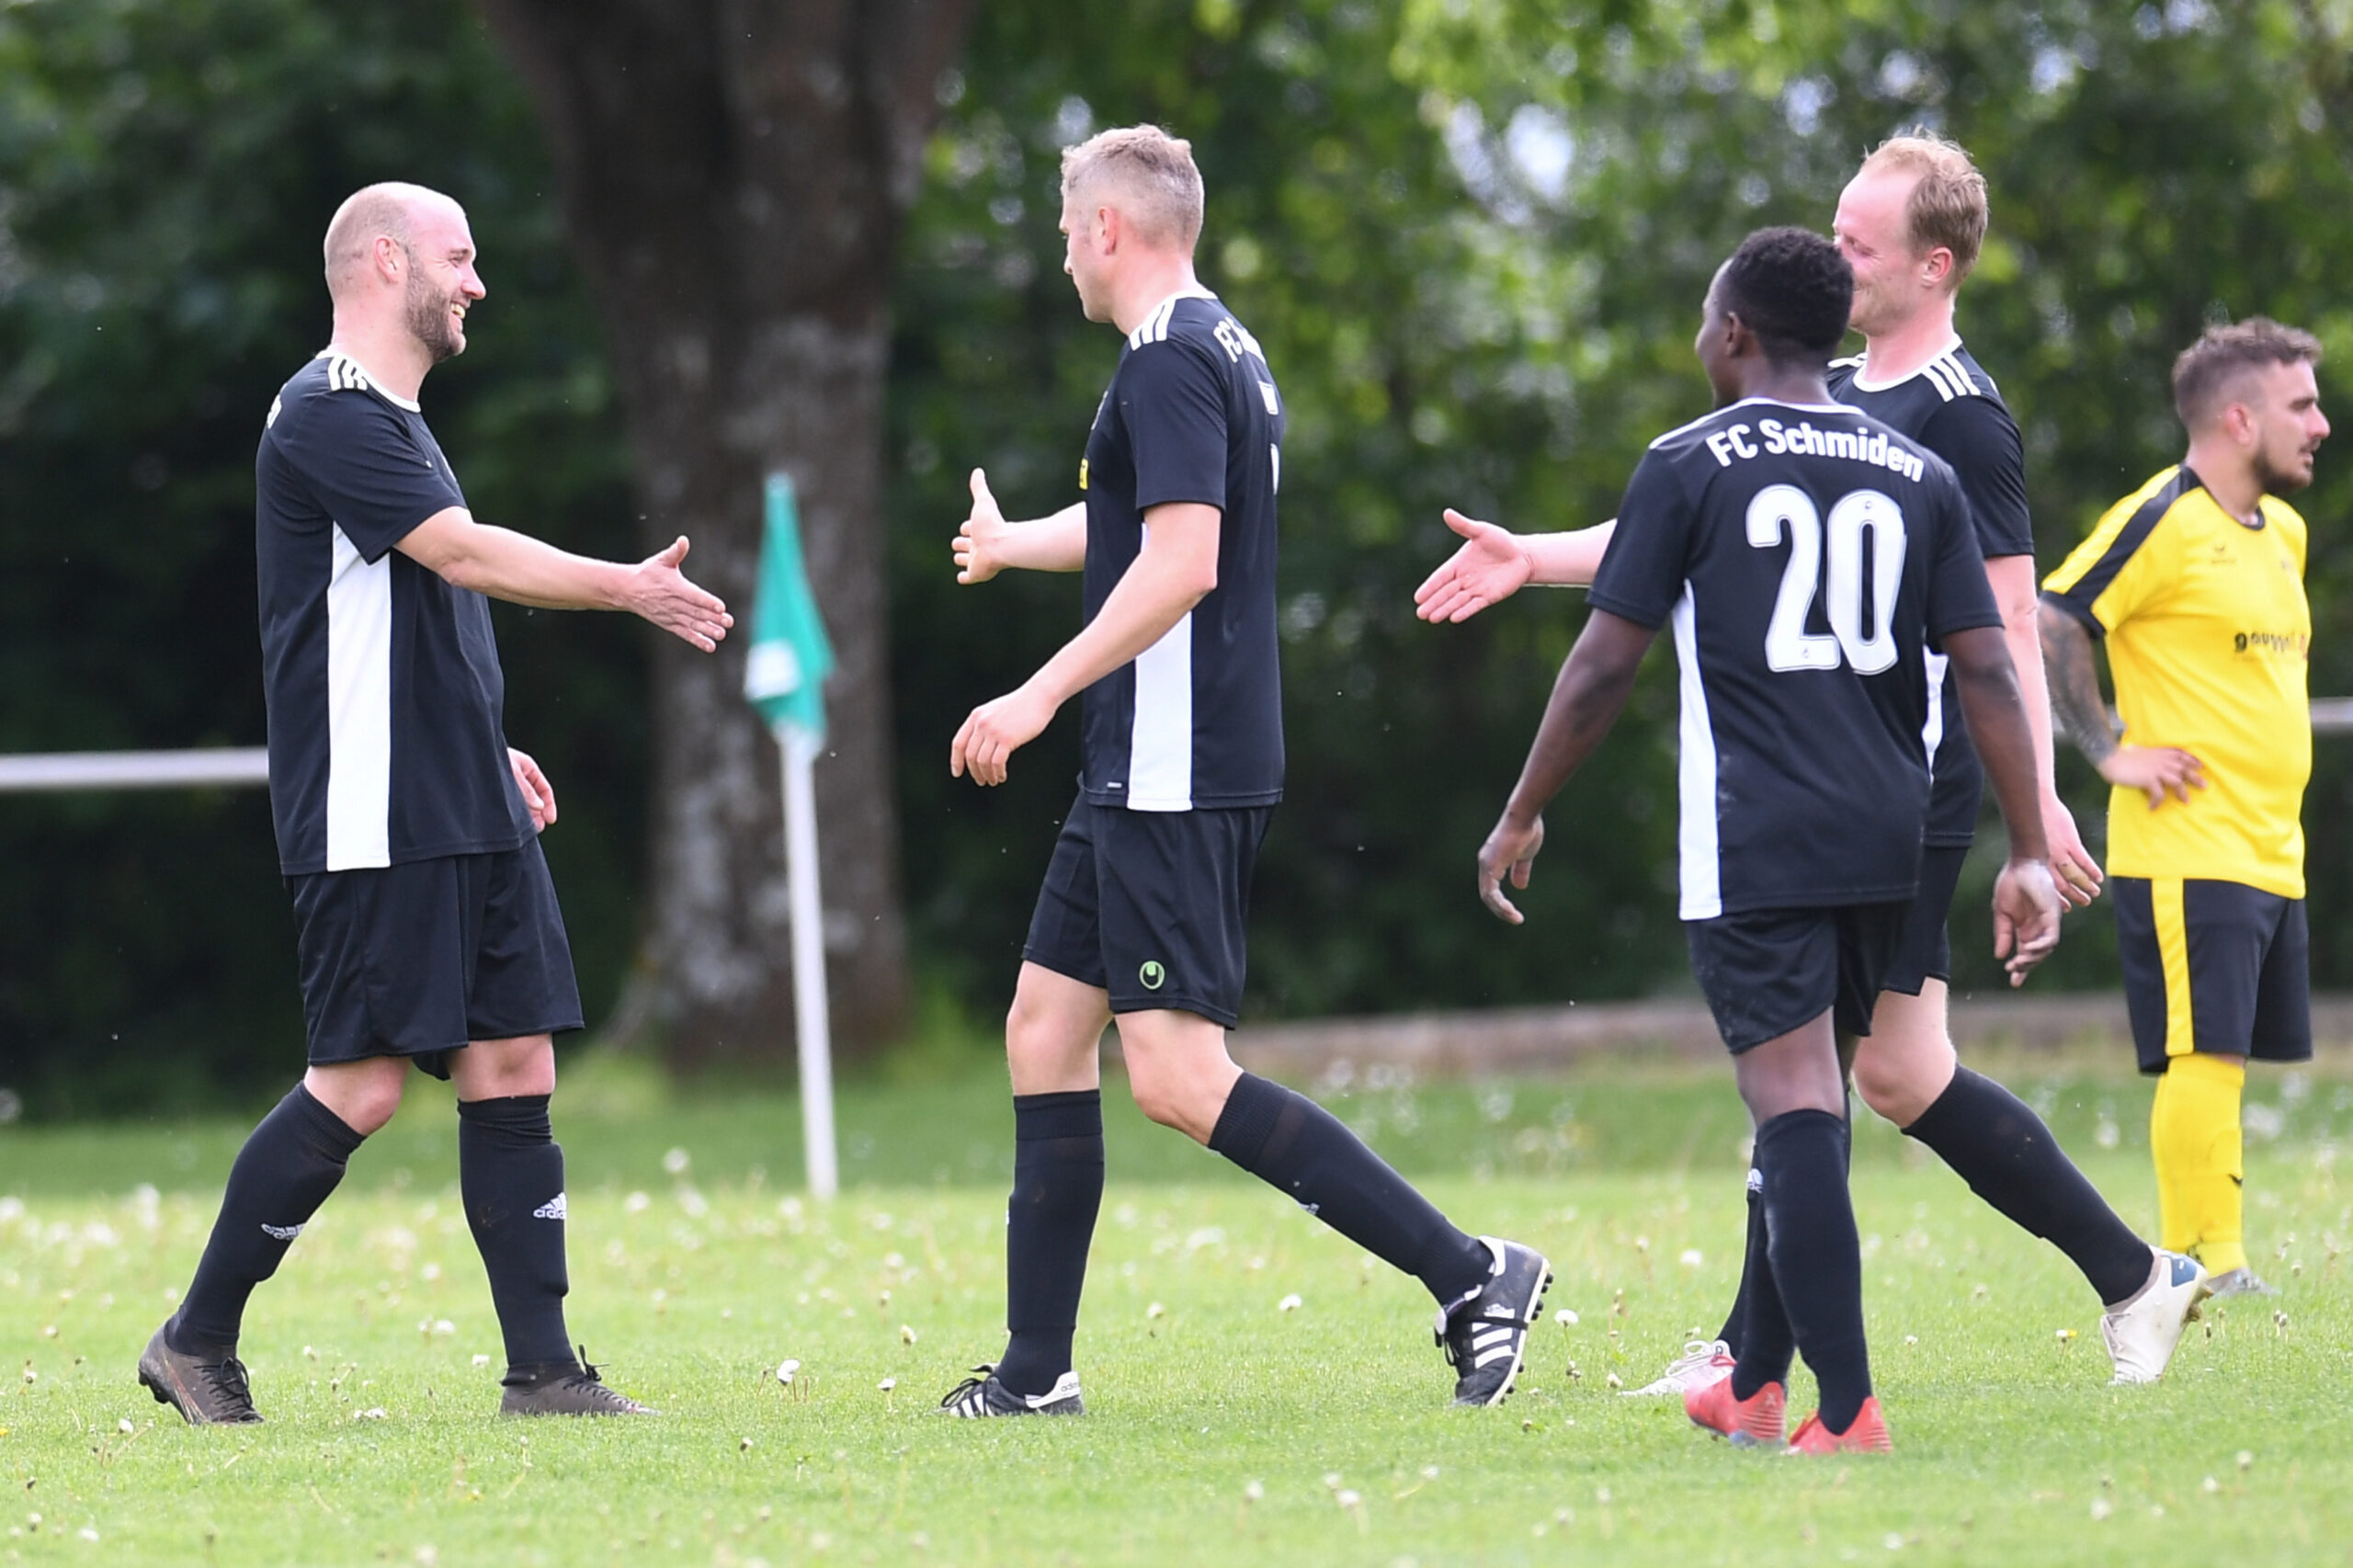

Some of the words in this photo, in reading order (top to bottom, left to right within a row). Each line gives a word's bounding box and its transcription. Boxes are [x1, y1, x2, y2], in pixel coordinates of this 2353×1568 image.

[1705, 422, 1759, 468] FC
[1758, 418, 1926, 483] Schmiden
[1745, 483, 1908, 676] 20
